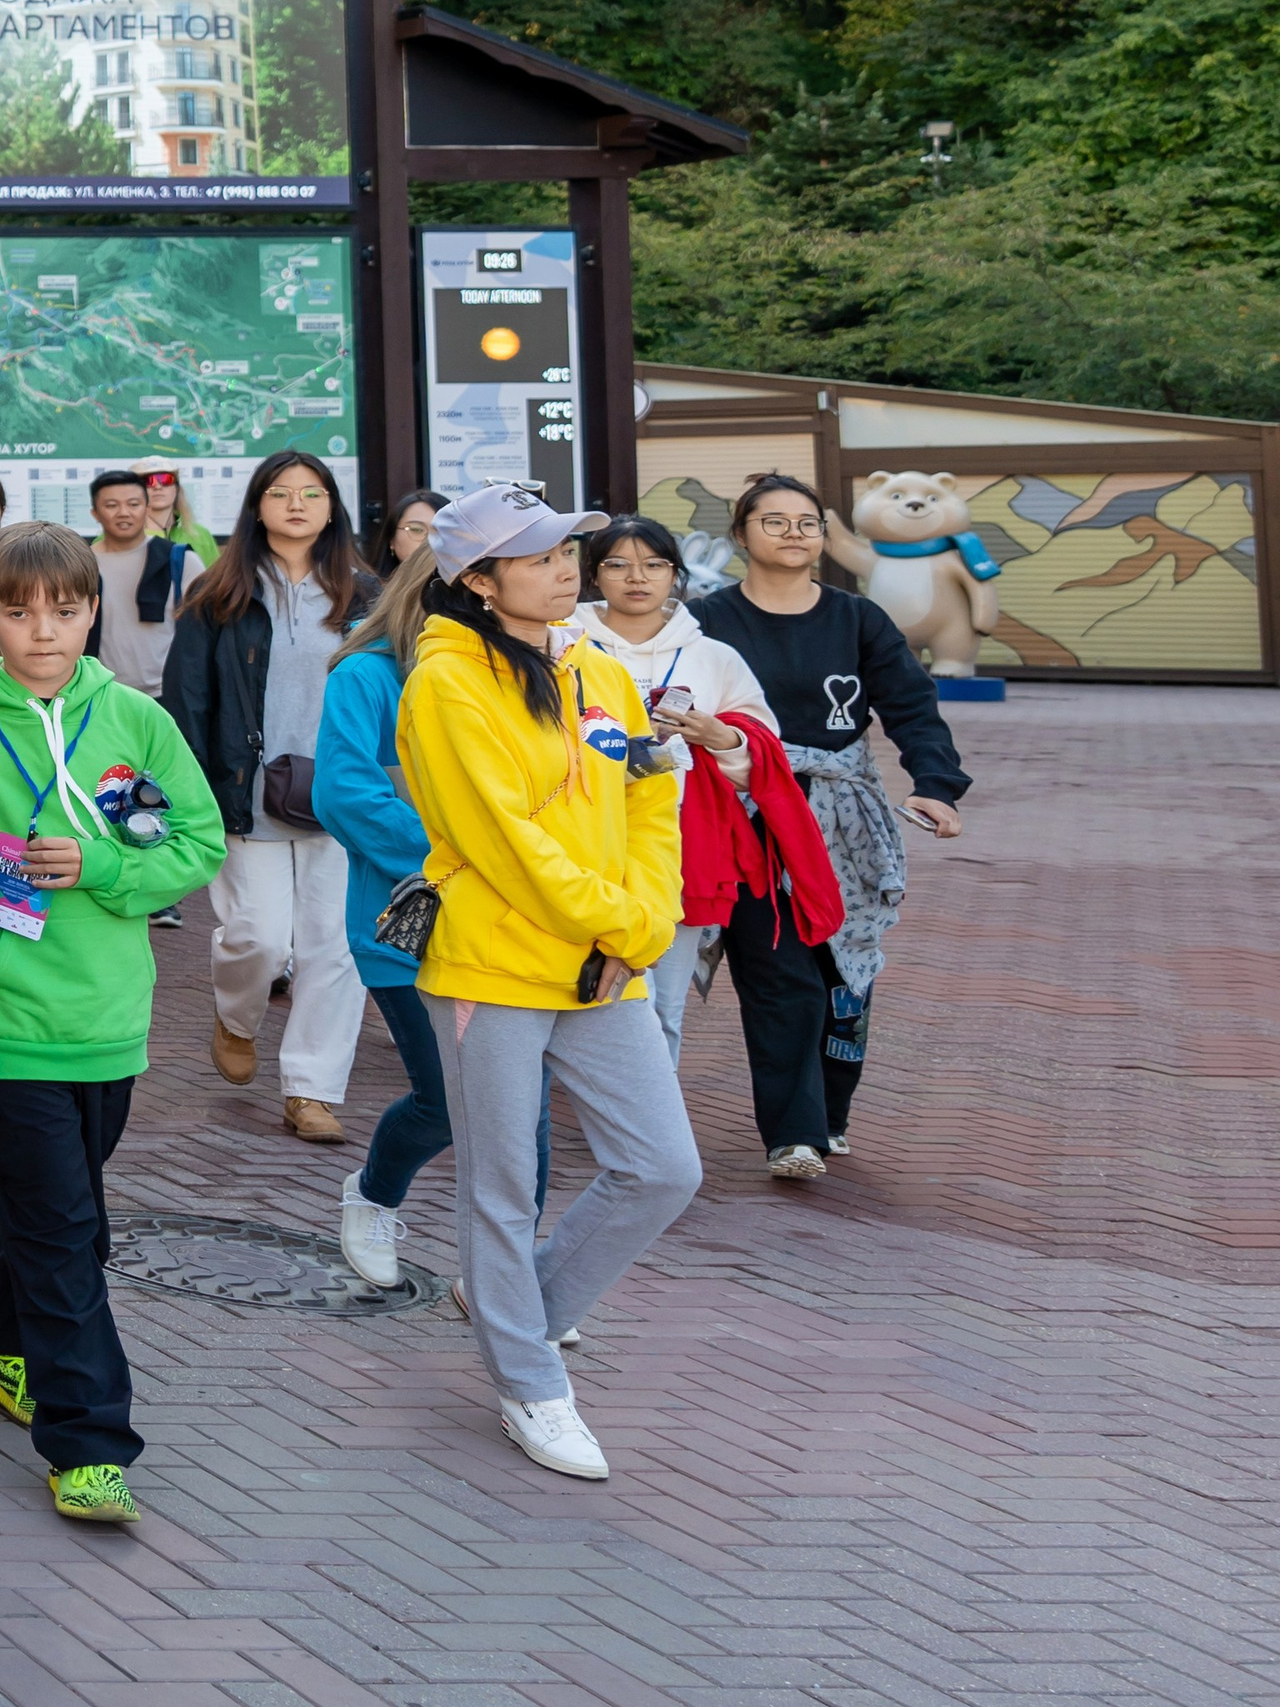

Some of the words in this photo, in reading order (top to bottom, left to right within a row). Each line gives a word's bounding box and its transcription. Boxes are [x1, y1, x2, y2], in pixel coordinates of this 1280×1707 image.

[11, 185, 73, 200] ПРОДАЖ:
[74, 185, 94, 199] УЛ.
[97, 185, 158, 200] КАМЕНКА,
[206, 185, 222, 199] +7
[460, 289, 489, 304] TODAY
[490, 289, 543, 304] AFTERNOON
[13, 442, 57, 455] ХУТОР
